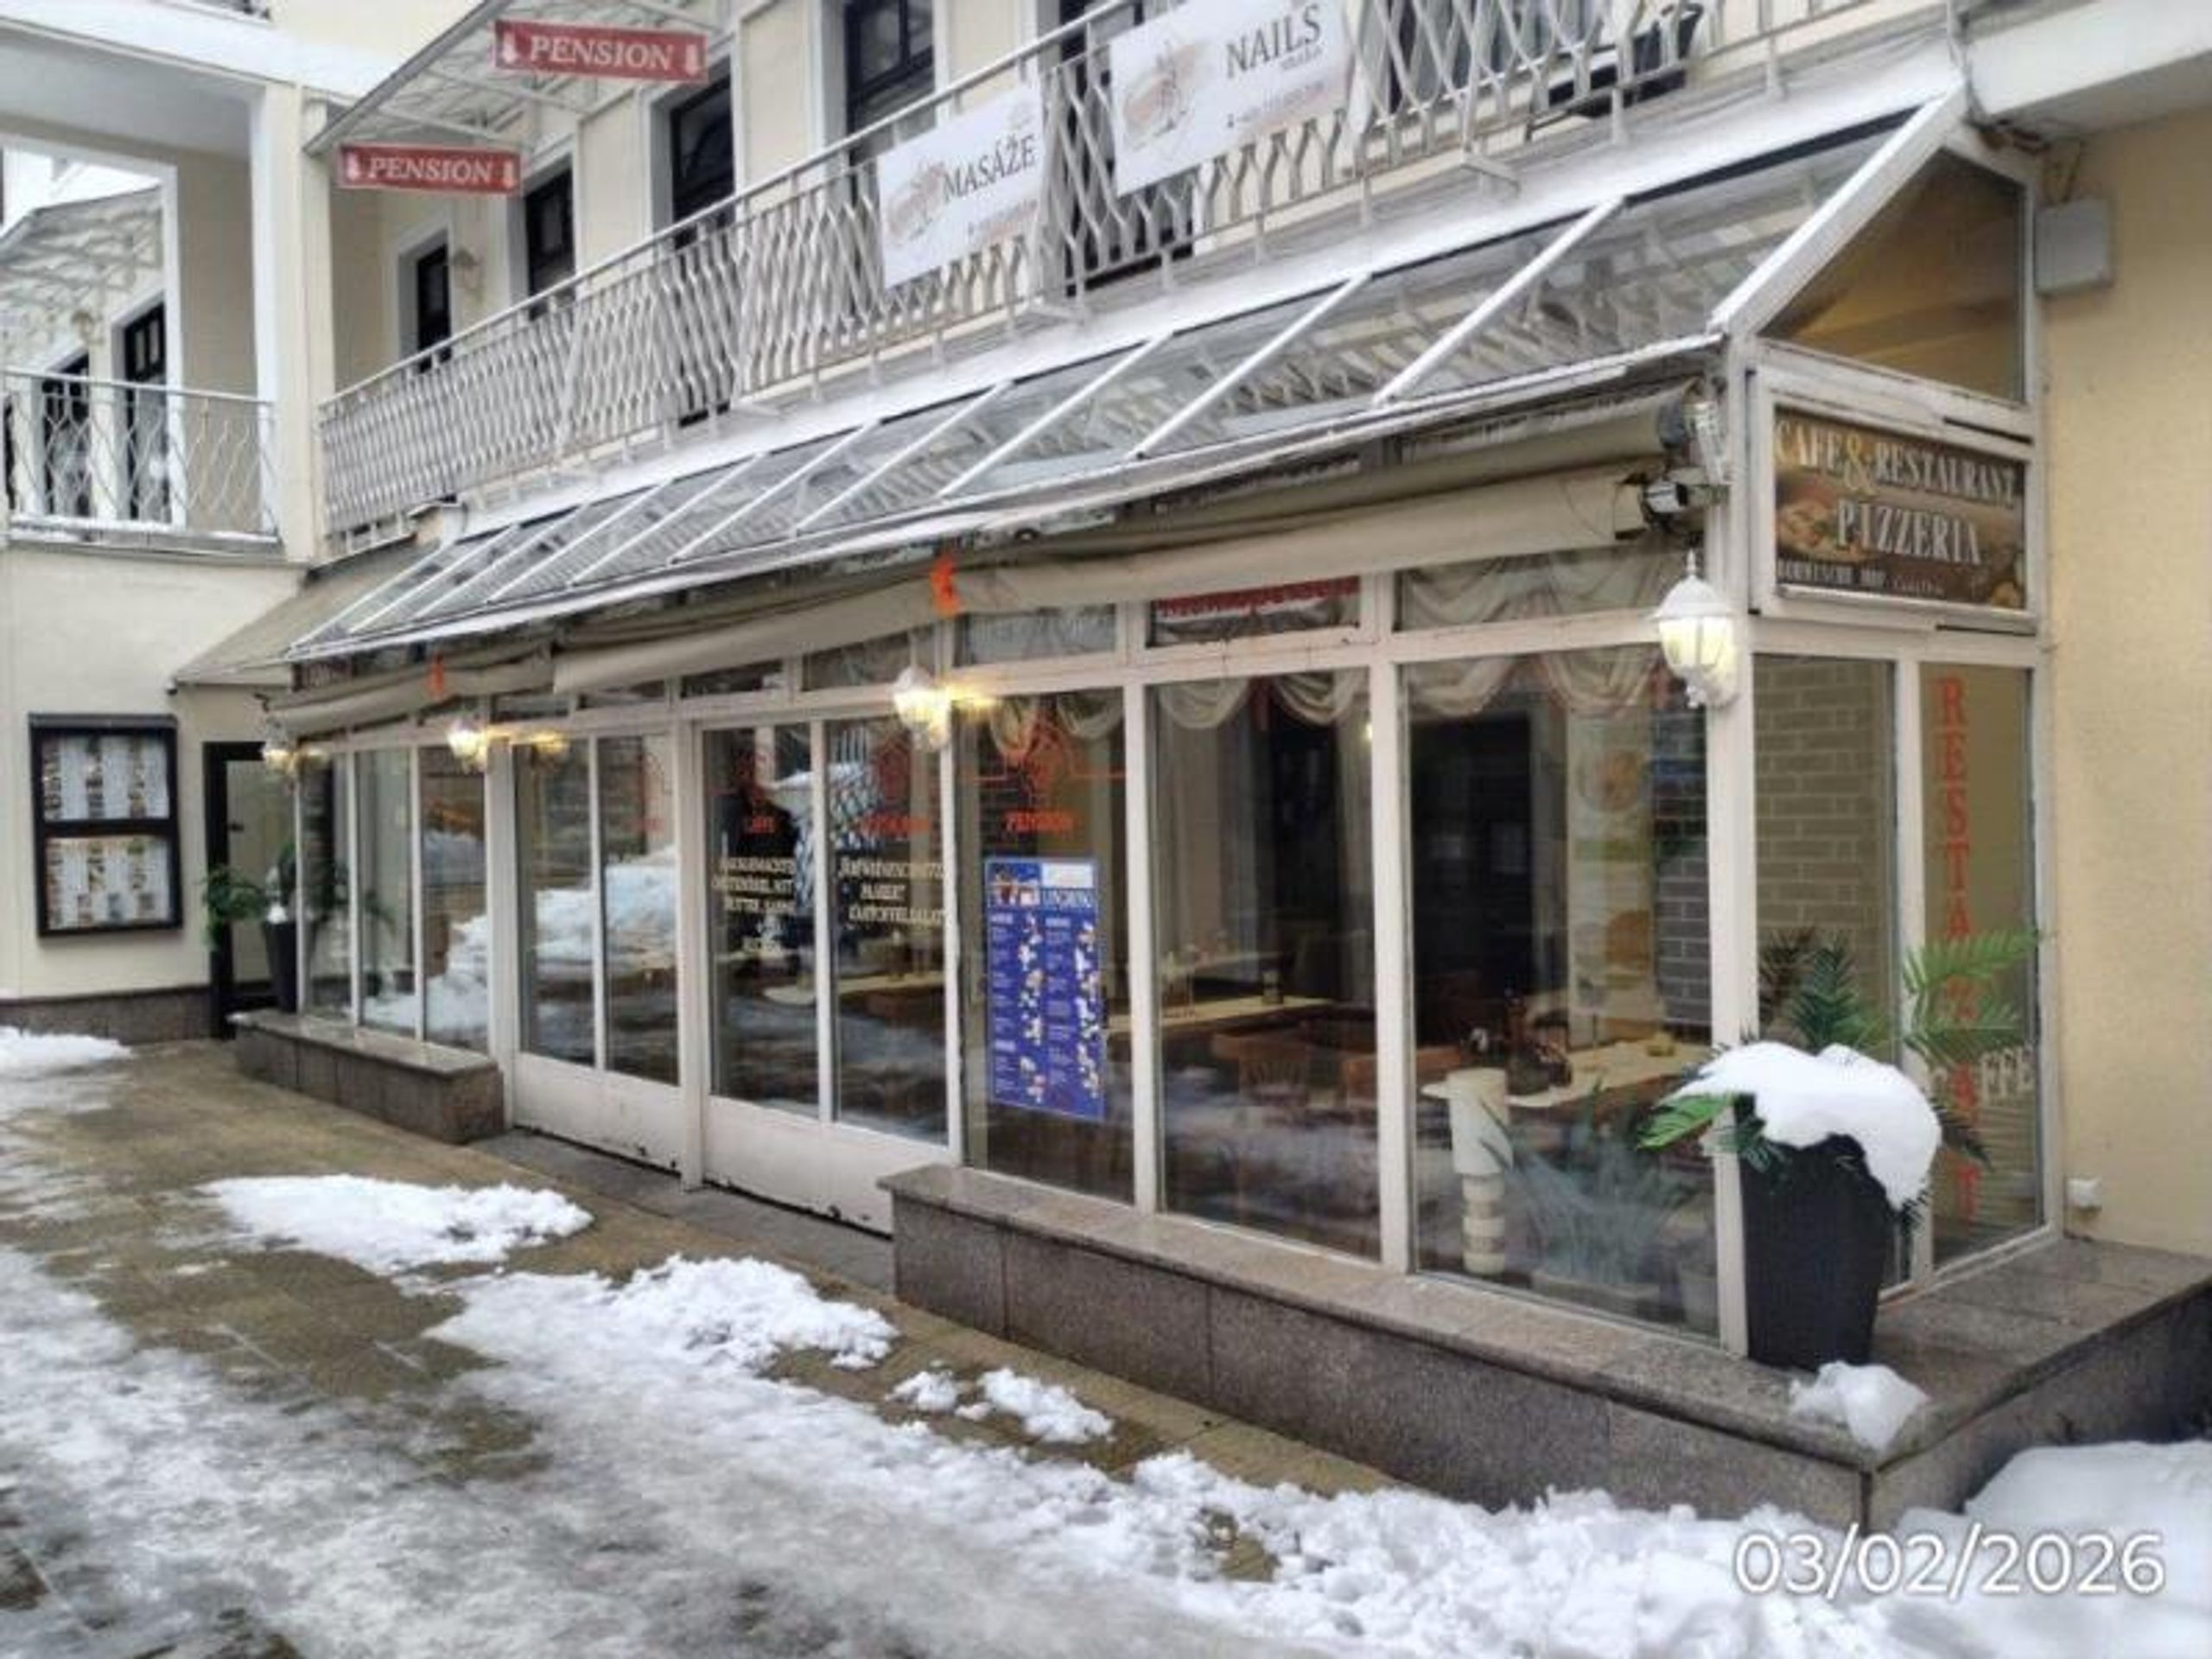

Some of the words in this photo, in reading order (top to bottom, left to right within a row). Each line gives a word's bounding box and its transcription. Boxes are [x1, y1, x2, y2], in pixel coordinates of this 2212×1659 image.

[530, 34, 674, 71] PENSION
[1227, 4, 1320, 79] NAILS
[368, 156, 495, 184] PENSION
[943, 134, 1036, 203] MASÁŽE
[1874, 442, 2017, 508] RESTAURANT
[1837, 498, 1981, 565] PIZZERIA
[1937, 677, 1980, 1222] RESTAAT
